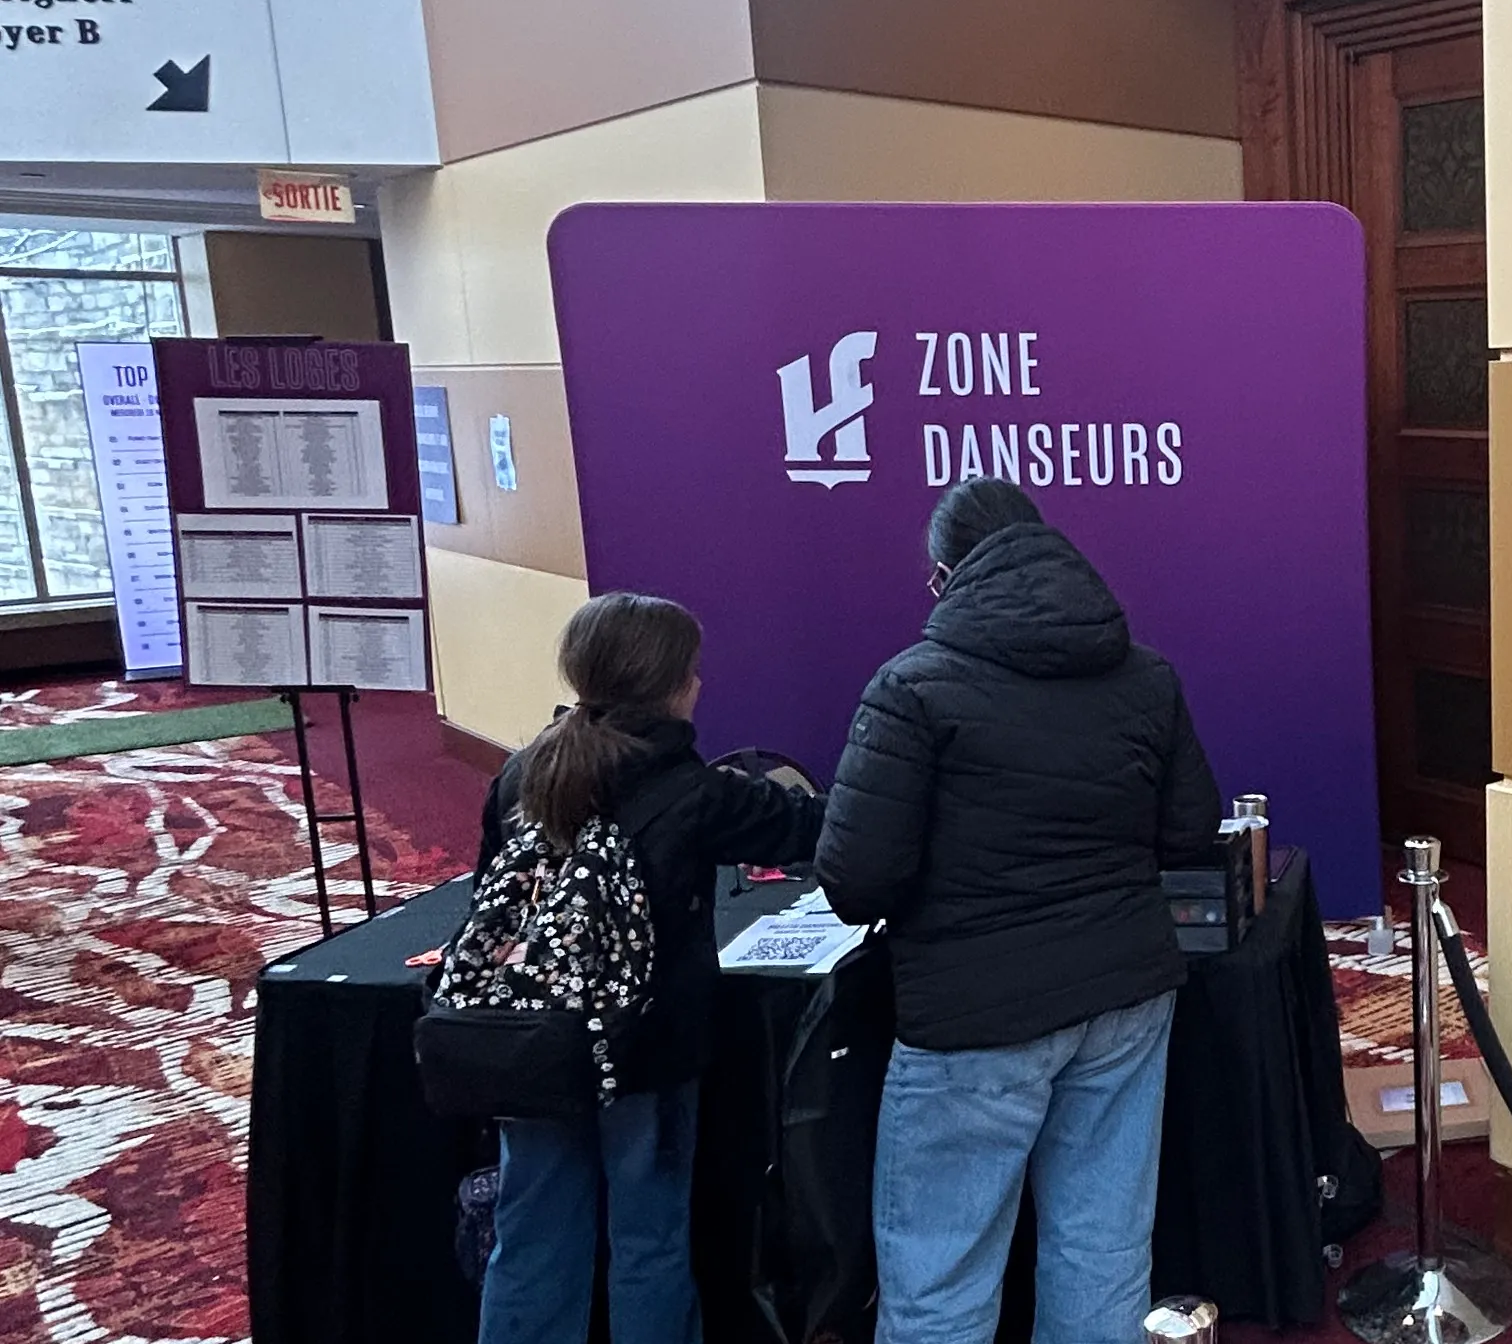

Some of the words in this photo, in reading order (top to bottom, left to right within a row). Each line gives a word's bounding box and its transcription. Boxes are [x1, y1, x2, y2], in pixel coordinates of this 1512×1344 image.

[0, 25, 63, 50] yer
[74, 19, 101, 45] B
[272, 183, 341, 211] SORTIE
[112, 365, 148, 387] TOP
[207, 345, 261, 389] LES
[268, 346, 360, 392] LOGES
[915, 332, 1041, 396] ZONE
[923, 422, 1183, 487] DANSEURS
